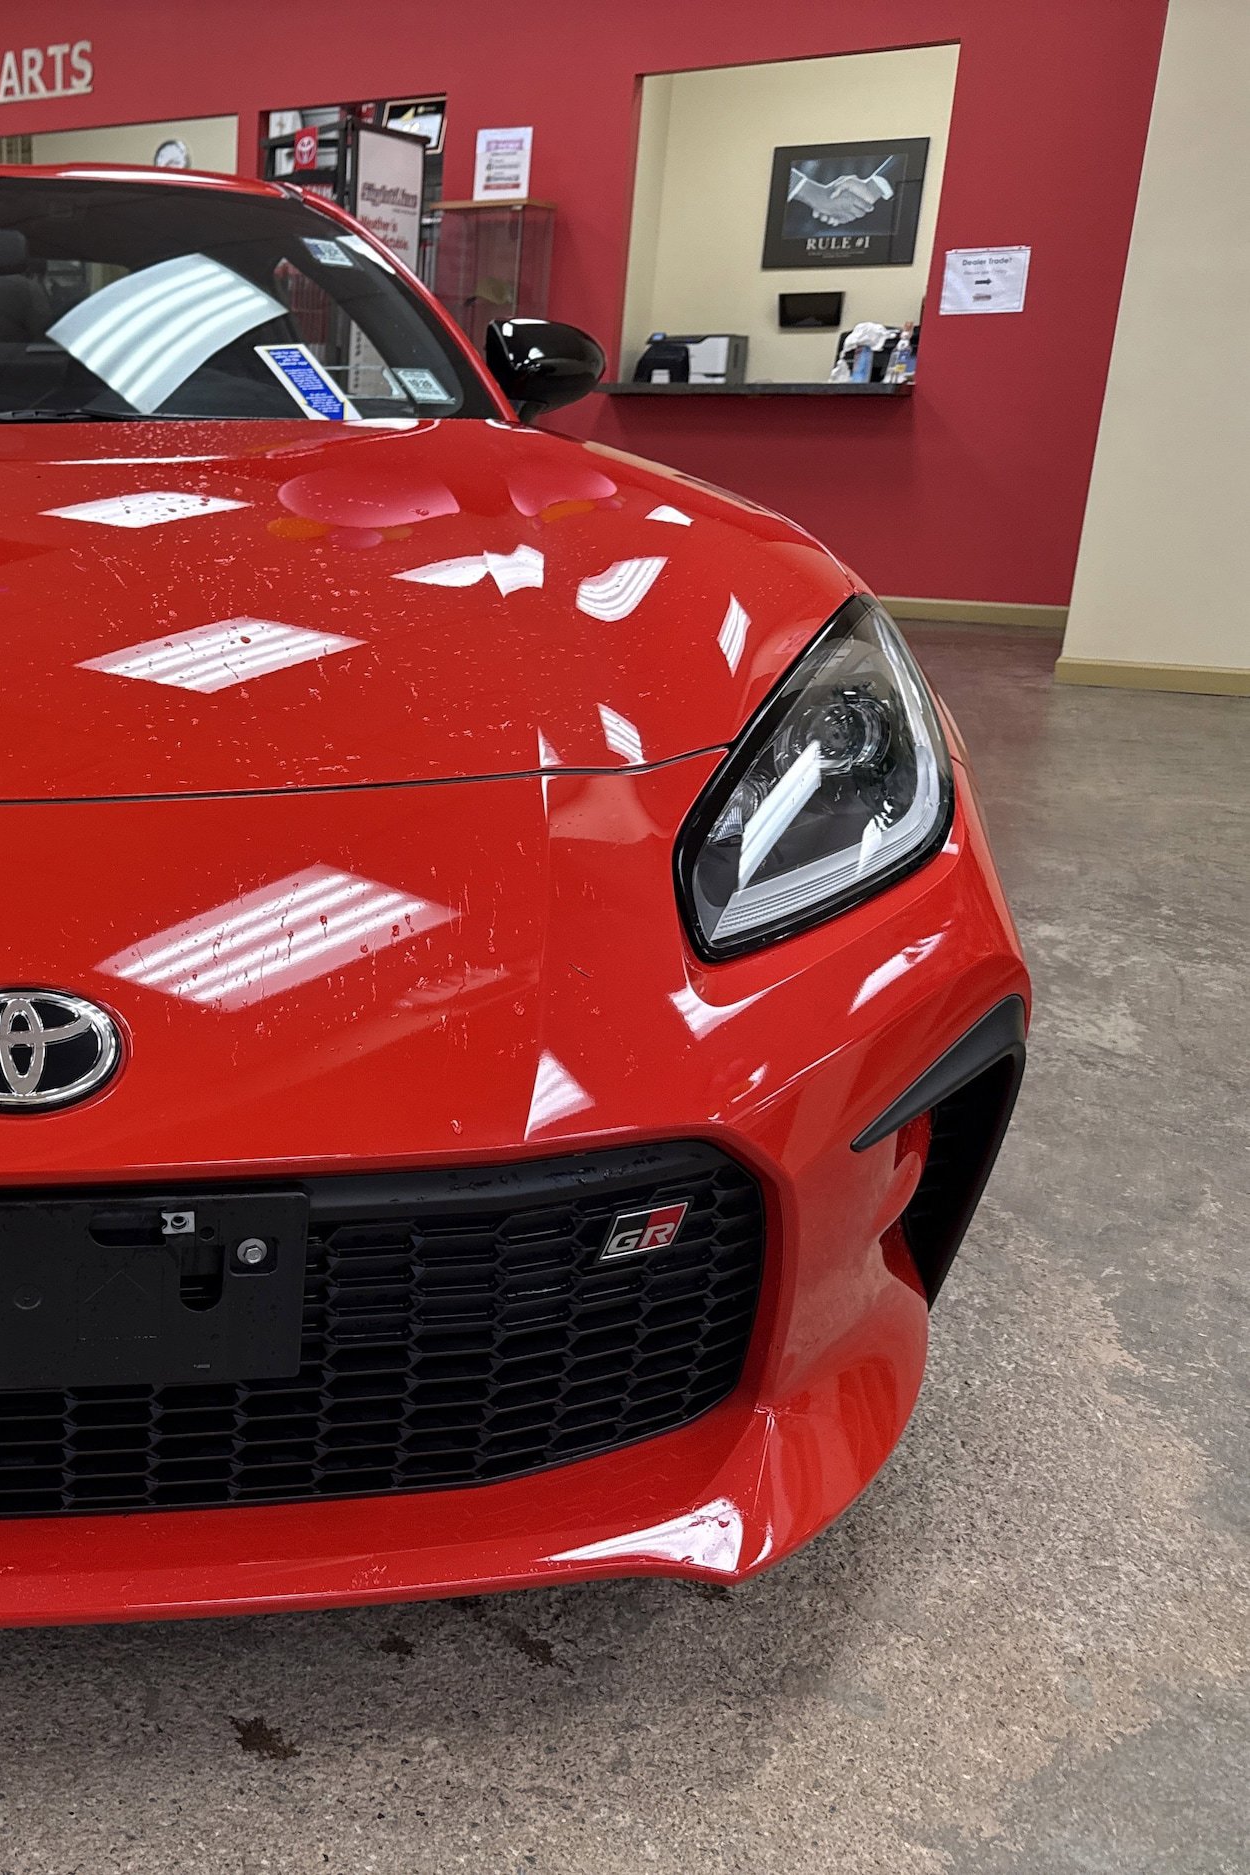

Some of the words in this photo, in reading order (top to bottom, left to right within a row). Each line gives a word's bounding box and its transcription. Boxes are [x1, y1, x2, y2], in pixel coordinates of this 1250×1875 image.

[806, 236, 851, 250] RULE
[855, 235, 870, 249] #1
[962, 258, 987, 266] Dealer
[607, 1222, 676, 1254] GR
